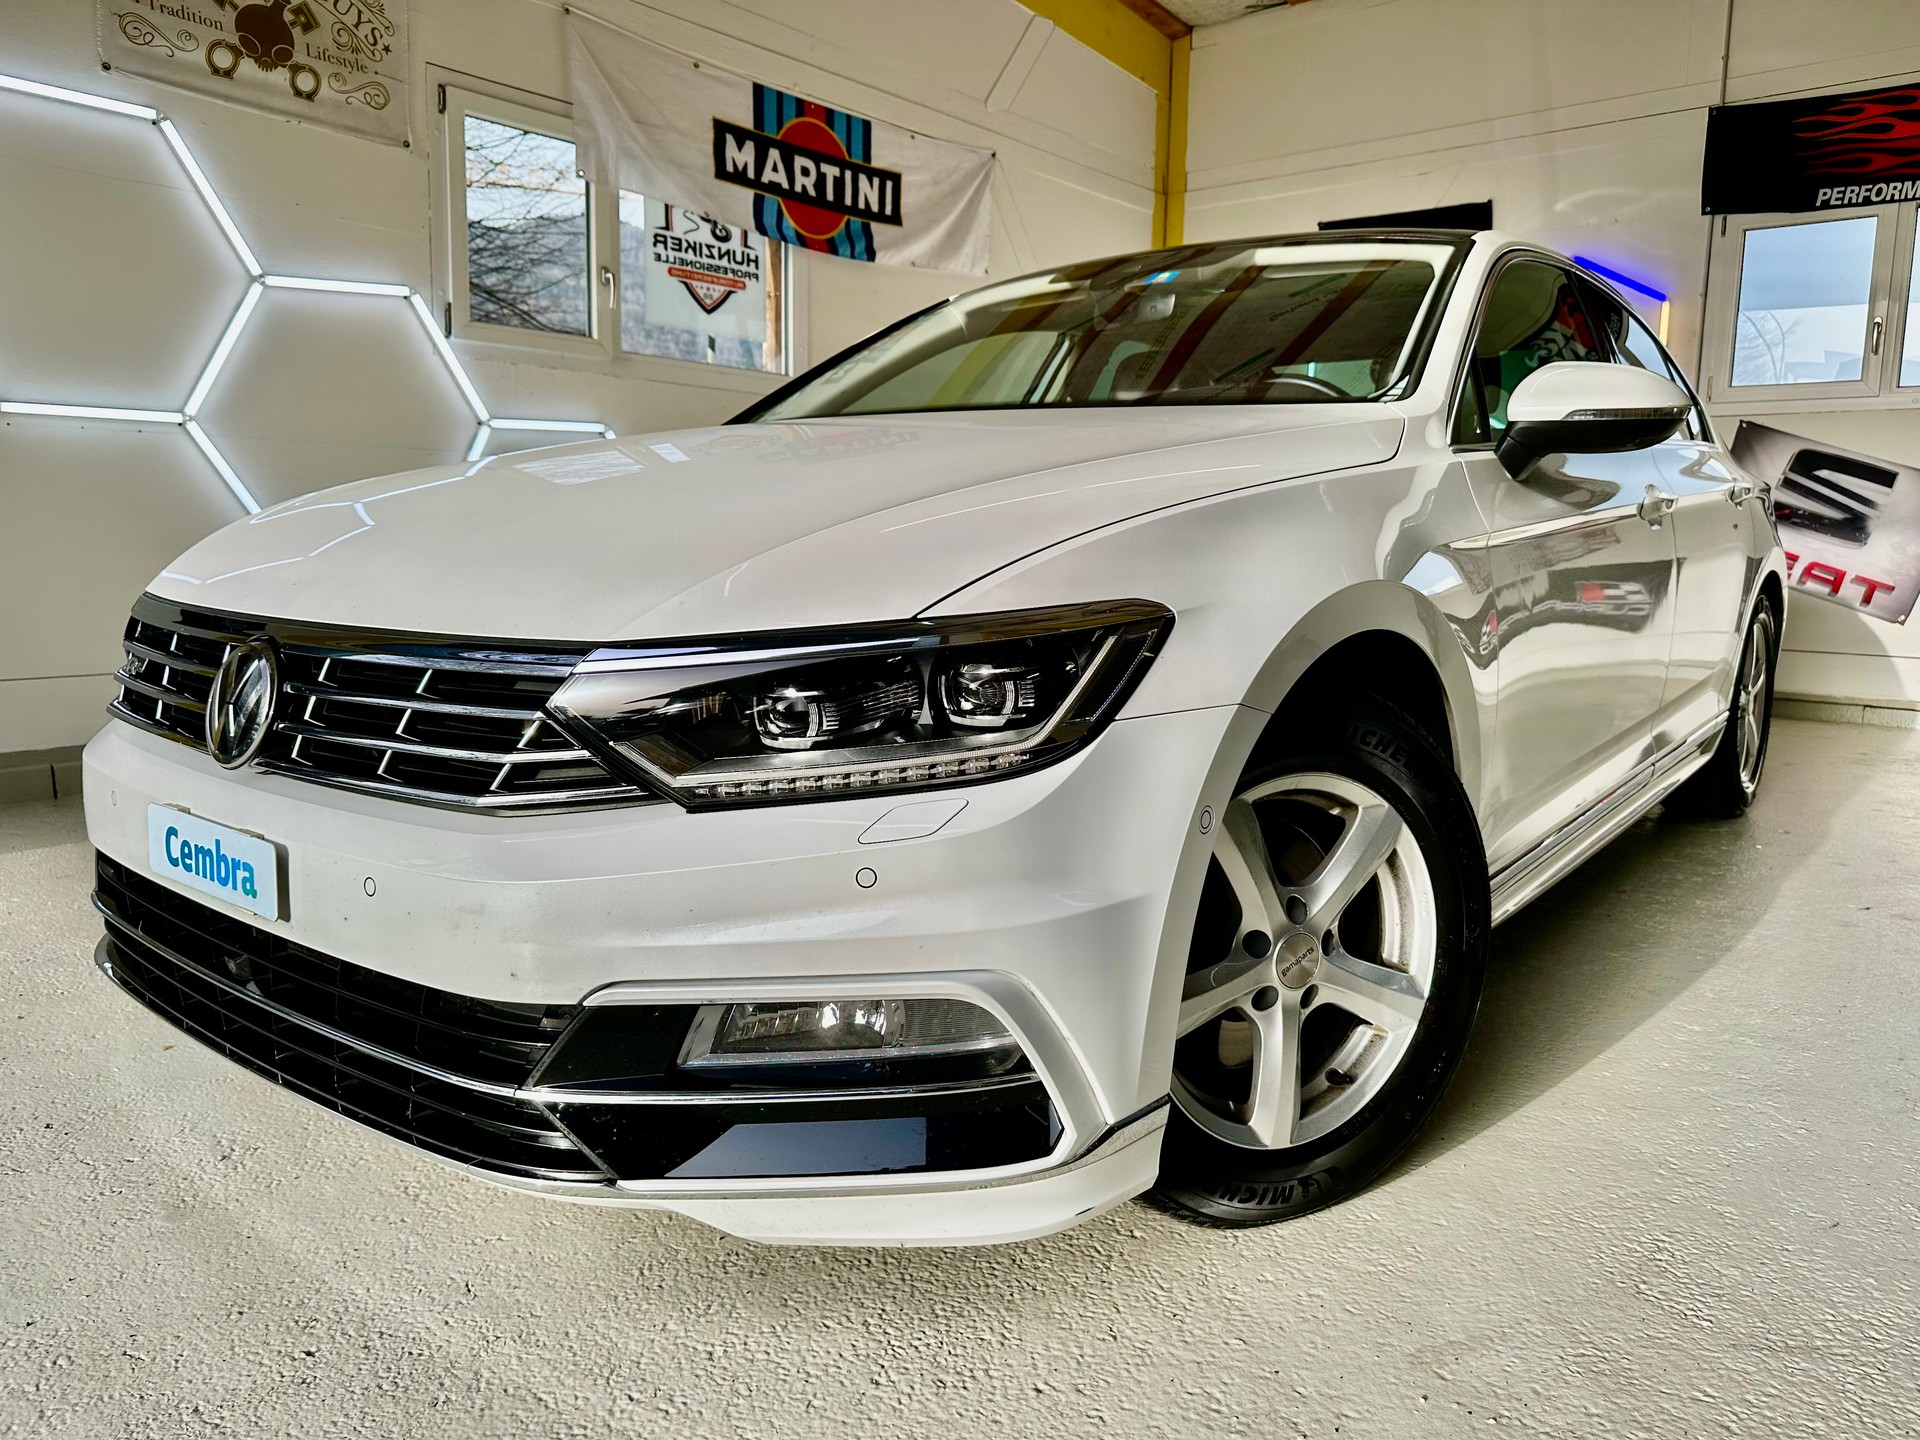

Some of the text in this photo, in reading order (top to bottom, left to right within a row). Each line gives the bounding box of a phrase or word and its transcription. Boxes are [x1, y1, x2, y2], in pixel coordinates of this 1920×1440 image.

[149, 0, 224, 32] Tradition
[332, 0, 384, 47] UYS
[305, 42, 369, 75] Lifestyle
[725, 133, 893, 216] MARTINI
[165, 826, 258, 899] Cembra
